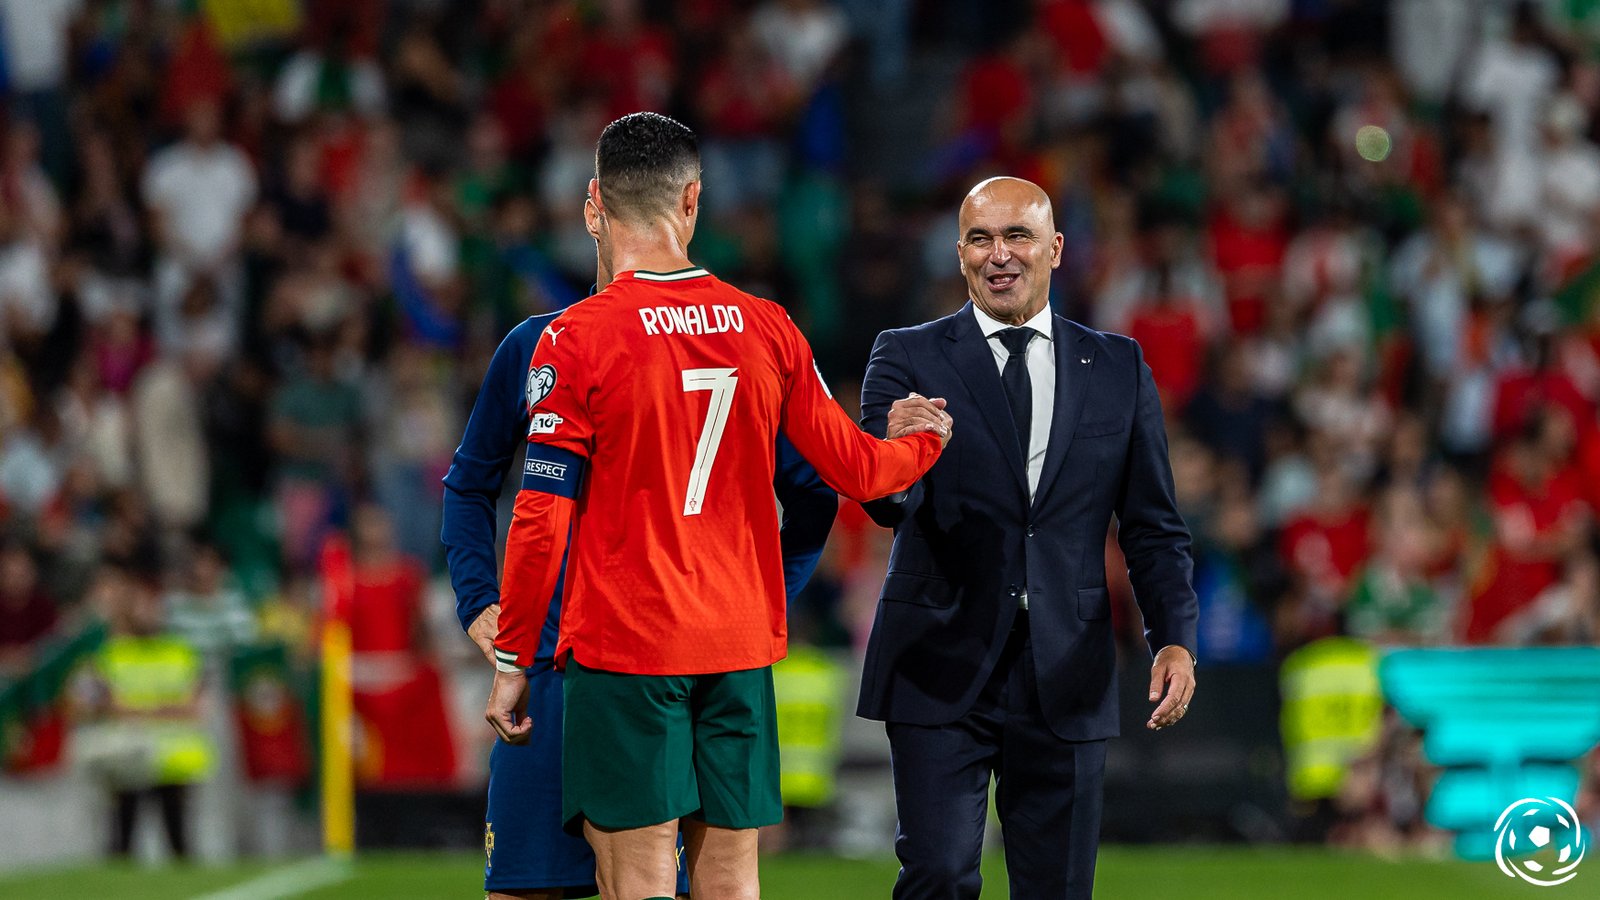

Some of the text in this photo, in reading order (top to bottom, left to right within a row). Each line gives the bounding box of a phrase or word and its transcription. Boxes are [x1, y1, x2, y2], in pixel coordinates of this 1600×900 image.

[638, 304, 744, 335] RONALDO
[681, 367, 738, 516] 7
[526, 461, 566, 477] RESPECT
